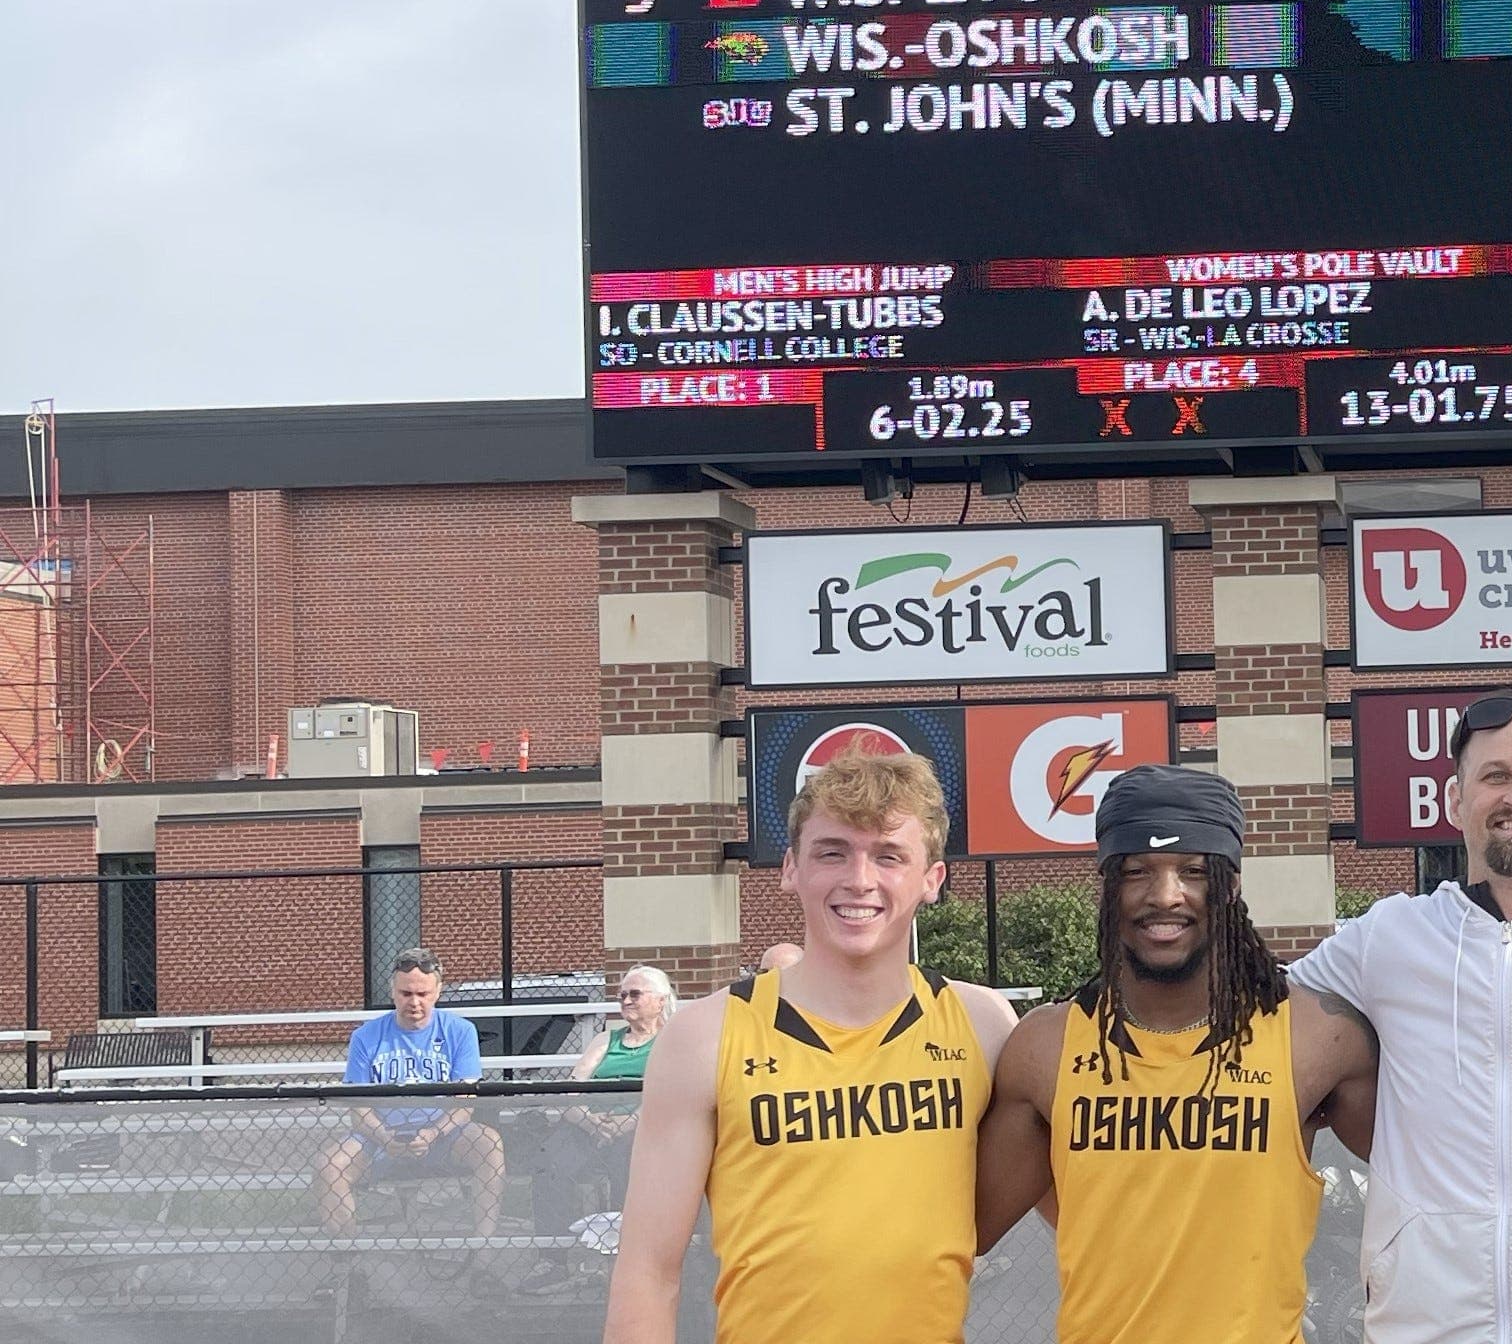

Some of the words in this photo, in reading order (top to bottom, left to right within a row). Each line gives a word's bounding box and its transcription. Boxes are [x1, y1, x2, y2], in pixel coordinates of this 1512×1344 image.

[782, 13, 1189, 73] WIS.-OSHKOSH
[786, 87, 869, 136] ST.
[883, 79, 1076, 133] JOHN'S
[1093, 73, 1294, 138] (MINN.)
[714, 269, 801, 295] MEN'S
[806, 268, 875, 292] HIGH
[880, 265, 953, 290] JUMP
[1165, 255, 1298, 282] WOMEN'S
[1306, 252, 1377, 277] POLE
[1379, 249, 1463, 274] VAULT
[628, 296, 944, 336] CLAUSSEN-TUBBS
[1082, 289, 1119, 322] A.
[1126, 288, 1173, 320] DE
[1182, 286, 1252, 318] LEO
[1260, 282, 1372, 316] LOPEZ
[600, 342, 637, 366] SO
[658, 338, 782, 364] CORNELL
[785, 336, 905, 360] COLLEGE
[1139, 324, 1241, 350] WIS.-LA
[1247, 322, 1350, 347] CROSSE
[907, 375, 994, 400] 1.89m
[1124, 361, 1229, 390] PLACE:
[1238, 359, 1259, 385] 4
[1389, 359, 1476, 385] 4.01m
[640, 375, 749, 403] PLACE:
[757, 374, 774, 399] 1
[869, 401, 1032, 440] 6-02.25
[809, 577, 1108, 655] festival
[1024, 642, 1080, 658] foods
[928, 1046, 967, 1062] WIAC
[1226, 1068, 1271, 1084] WIAC
[750, 1077, 963, 1146] OSHKOSH
[1069, 1096, 1270, 1152] OSHKOSH
